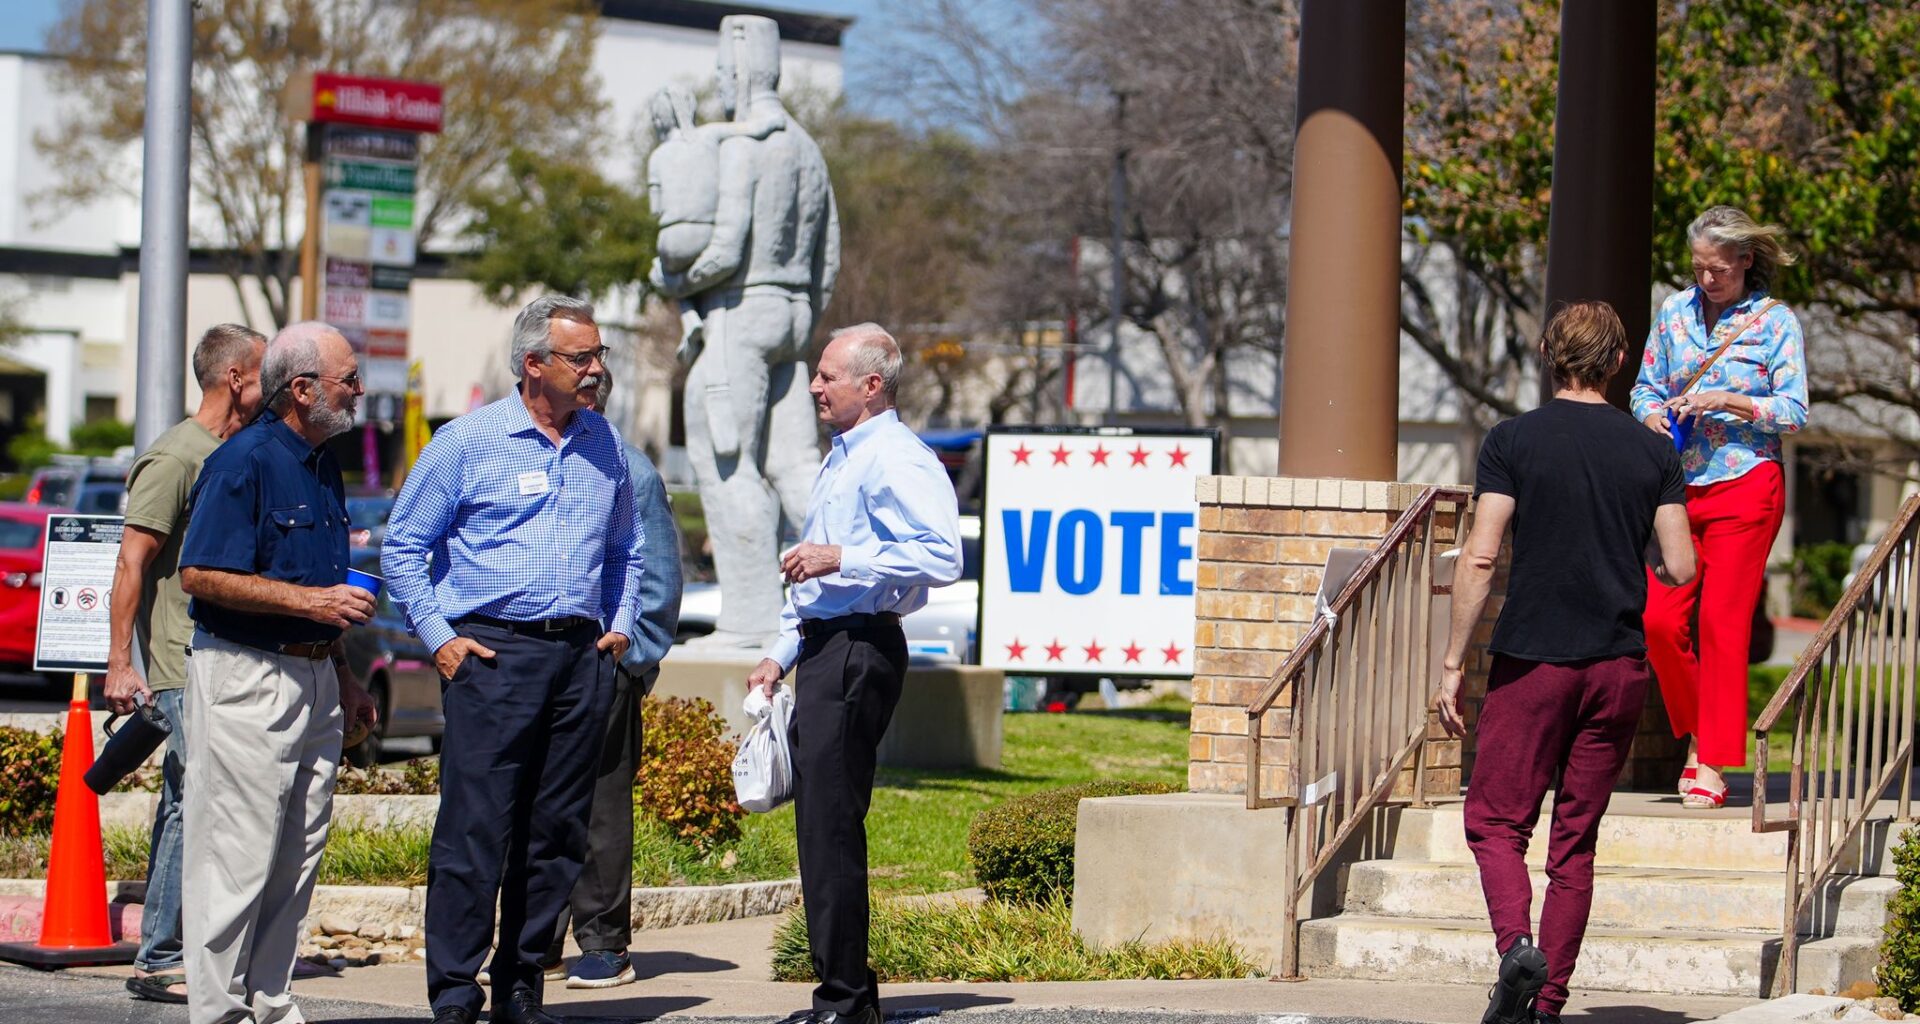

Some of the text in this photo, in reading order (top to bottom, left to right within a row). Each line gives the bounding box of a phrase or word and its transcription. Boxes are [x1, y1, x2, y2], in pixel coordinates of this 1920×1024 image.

[337, 85, 441, 122] Hillside Center
[1002, 509, 1194, 596] VOTE
